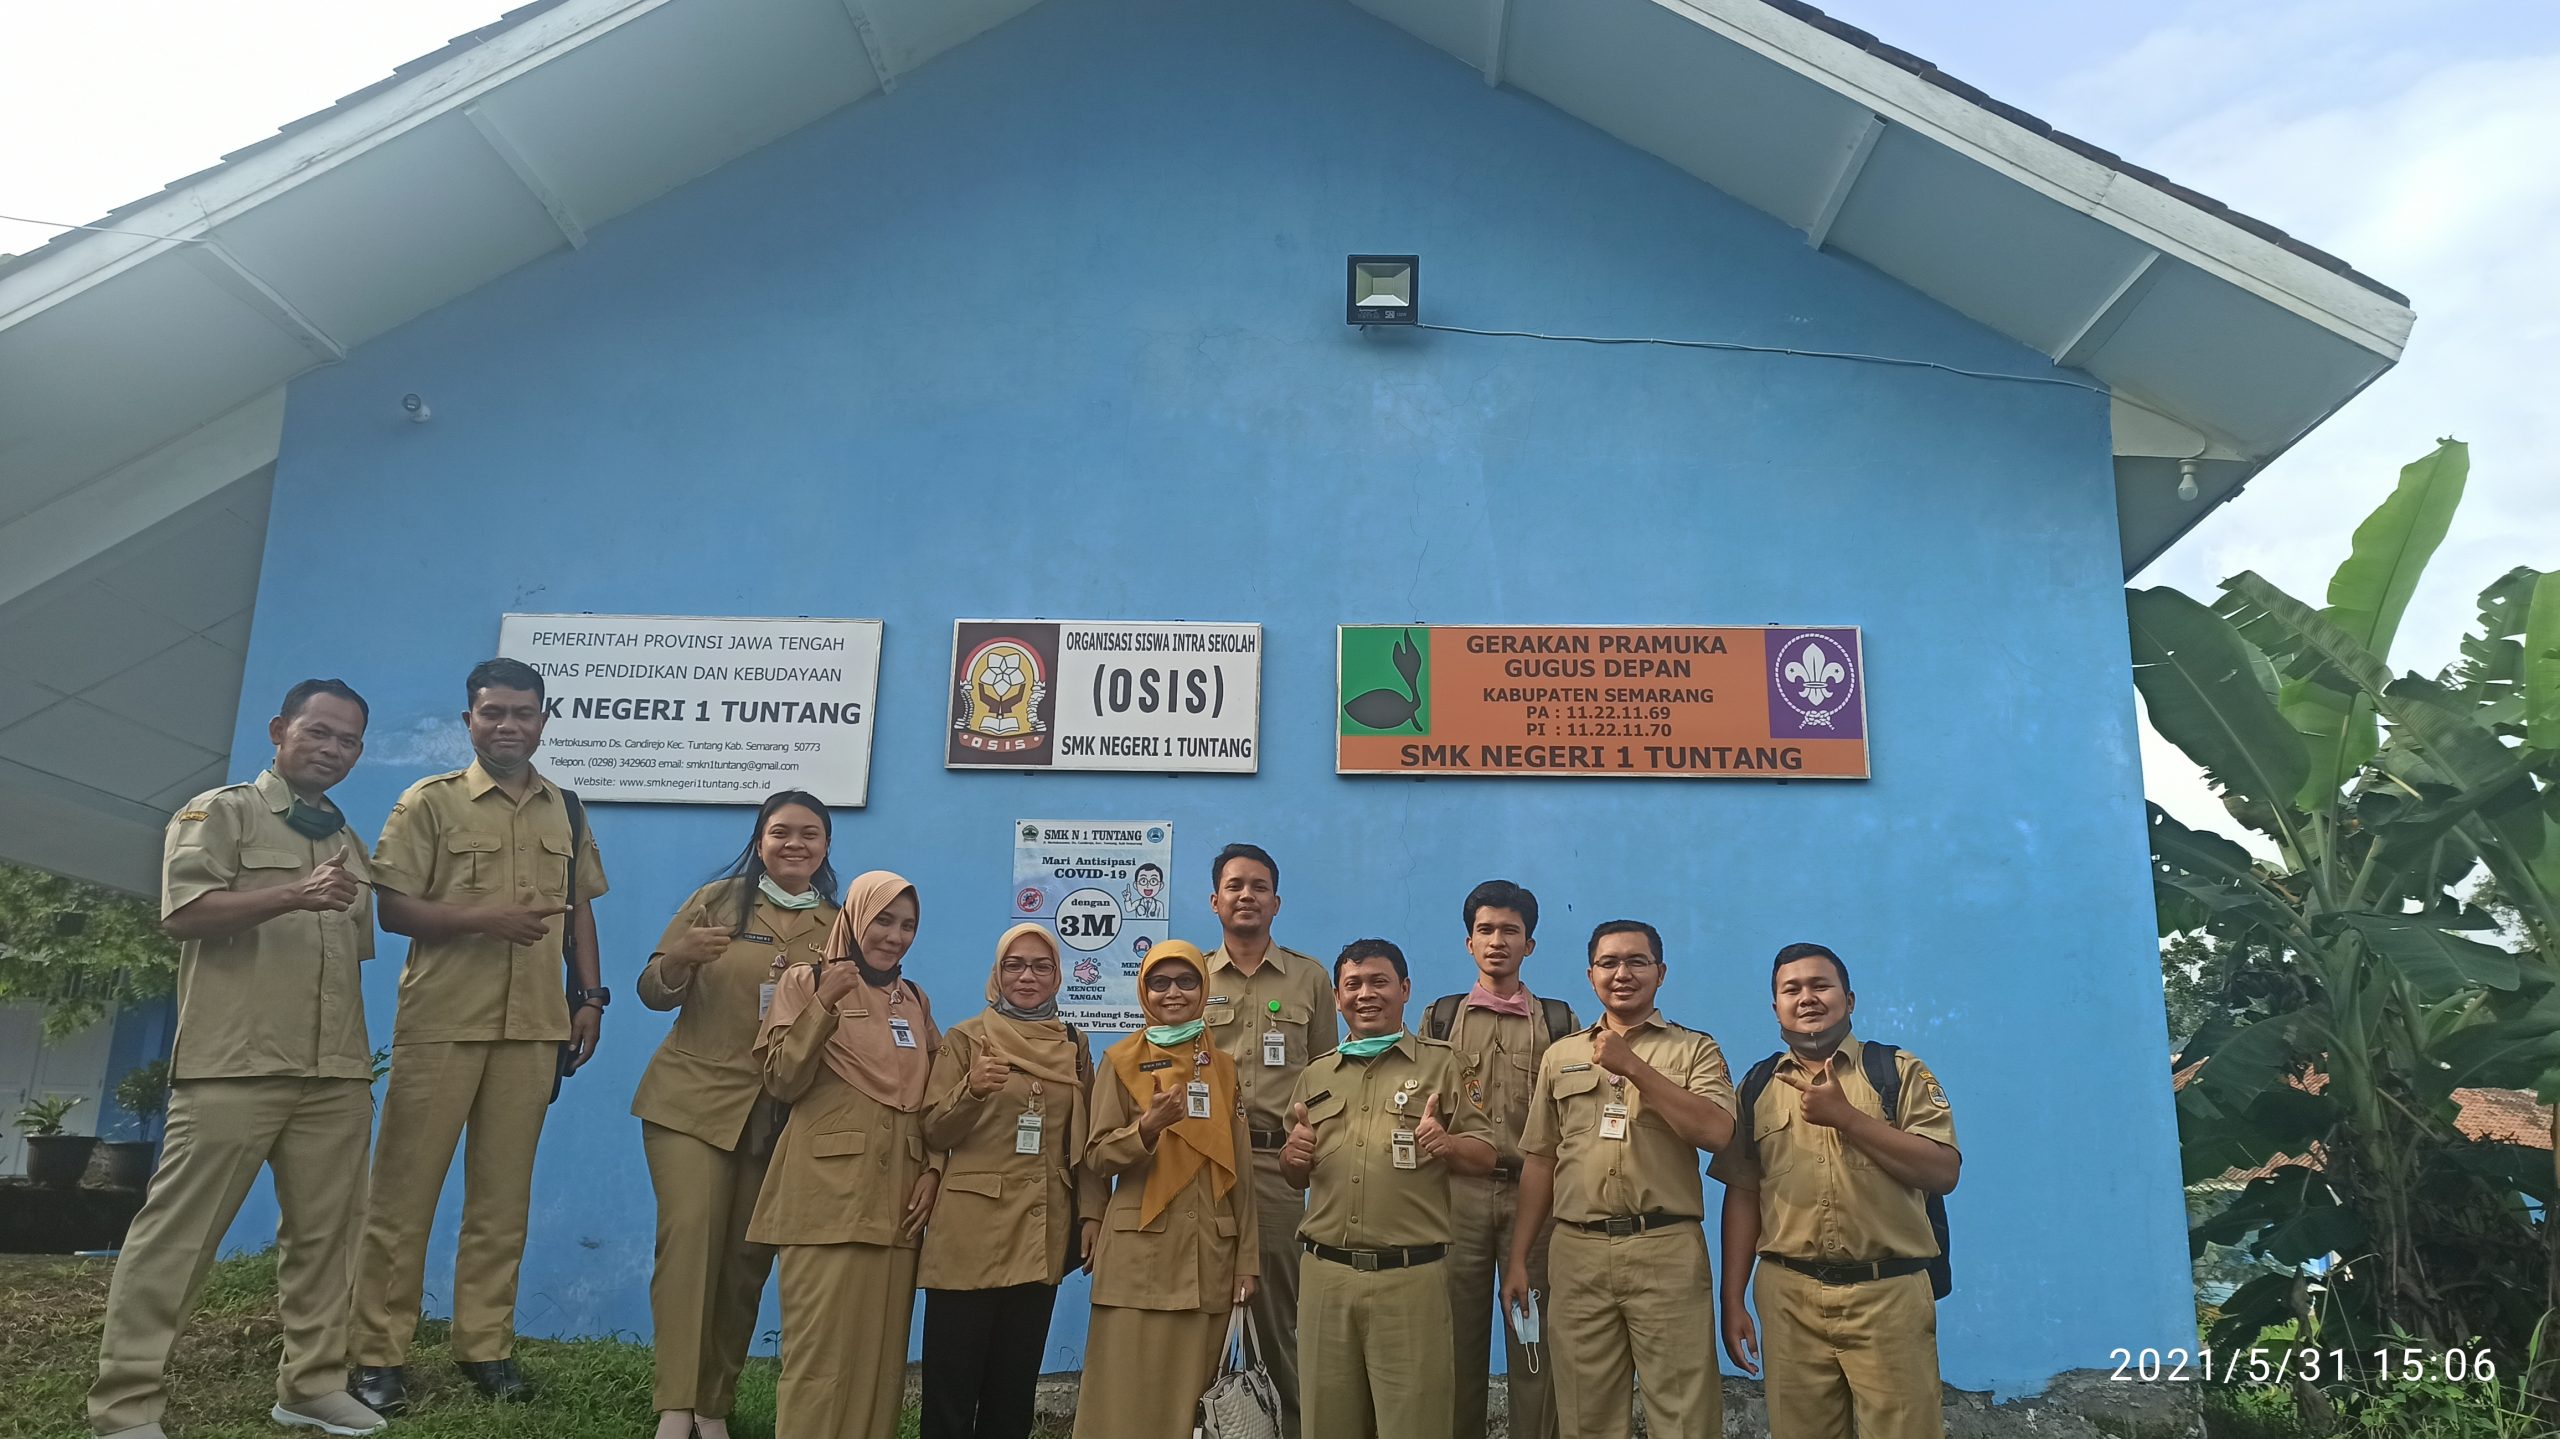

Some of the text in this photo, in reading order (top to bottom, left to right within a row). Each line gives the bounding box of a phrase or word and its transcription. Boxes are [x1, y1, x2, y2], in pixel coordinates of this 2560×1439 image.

[532, 632, 845, 651] PEMERINTAH PROVINSI JAWA TENGAH
[1066, 632, 1255, 653] ORGANISASI SISWA INTRA SEKOLAH
[1466, 635, 1728, 654] GERAKAN PRAMUKA
[585, 663, 688, 679] PENDIDIKAN
[693, 666, 728, 680] DAN
[734, 667, 842, 682] KEBUDAYAAN
[1504, 659, 1691, 678] GUGUS DEPAN
[1093, 663, 1224, 718] (OSIS)
[1483, 688, 1714, 703] KABUPATEN SEMARANG
[572, 697, 686, 721] NEGERI
[695, 701, 710, 722] 1
[721, 701, 861, 725] TUNTANG
[1526, 706, 1550, 719] PA
[1567, 706, 1671, 720] 11.22.11.69
[1526, 723, 1545, 736] PI
[1567, 723, 1672, 737] 11.22.11.70
[549, 738, 607, 748] Mertokusumo
[625, 739, 665, 750] Candirejo
[667, 740, 685, 749] Kec.
[688, 741, 723, 752] Tuntang
[725, 741, 743, 751] Kab.
[746, 742, 789, 753] Semarang
[794, 743, 821, 752] 50773
[971, 737, 1026, 751] OSIS
[1061, 736, 1252, 758] SMK NEGERI 1 TUNTANG
[550, 757, 585, 768] Telepon.
[588, 757, 617, 769] (0298)
[619, 759, 656, 768] 3429603
[1400, 745, 1803, 770] SMK NEGERI 1 TUNTANG
[574, 777, 615, 786] Website:
[1044, 829, 1142, 841] SMK N 1 TUNTANG
[1042, 857, 1136, 867] Mari Antisipasi
[1054, 868, 1127, 879] COVID-19
[1071, 898, 1110, 907] dengan
[1060, 914, 1115, 937] 3M
[1080, 1011, 1121, 1019] Lindungi
